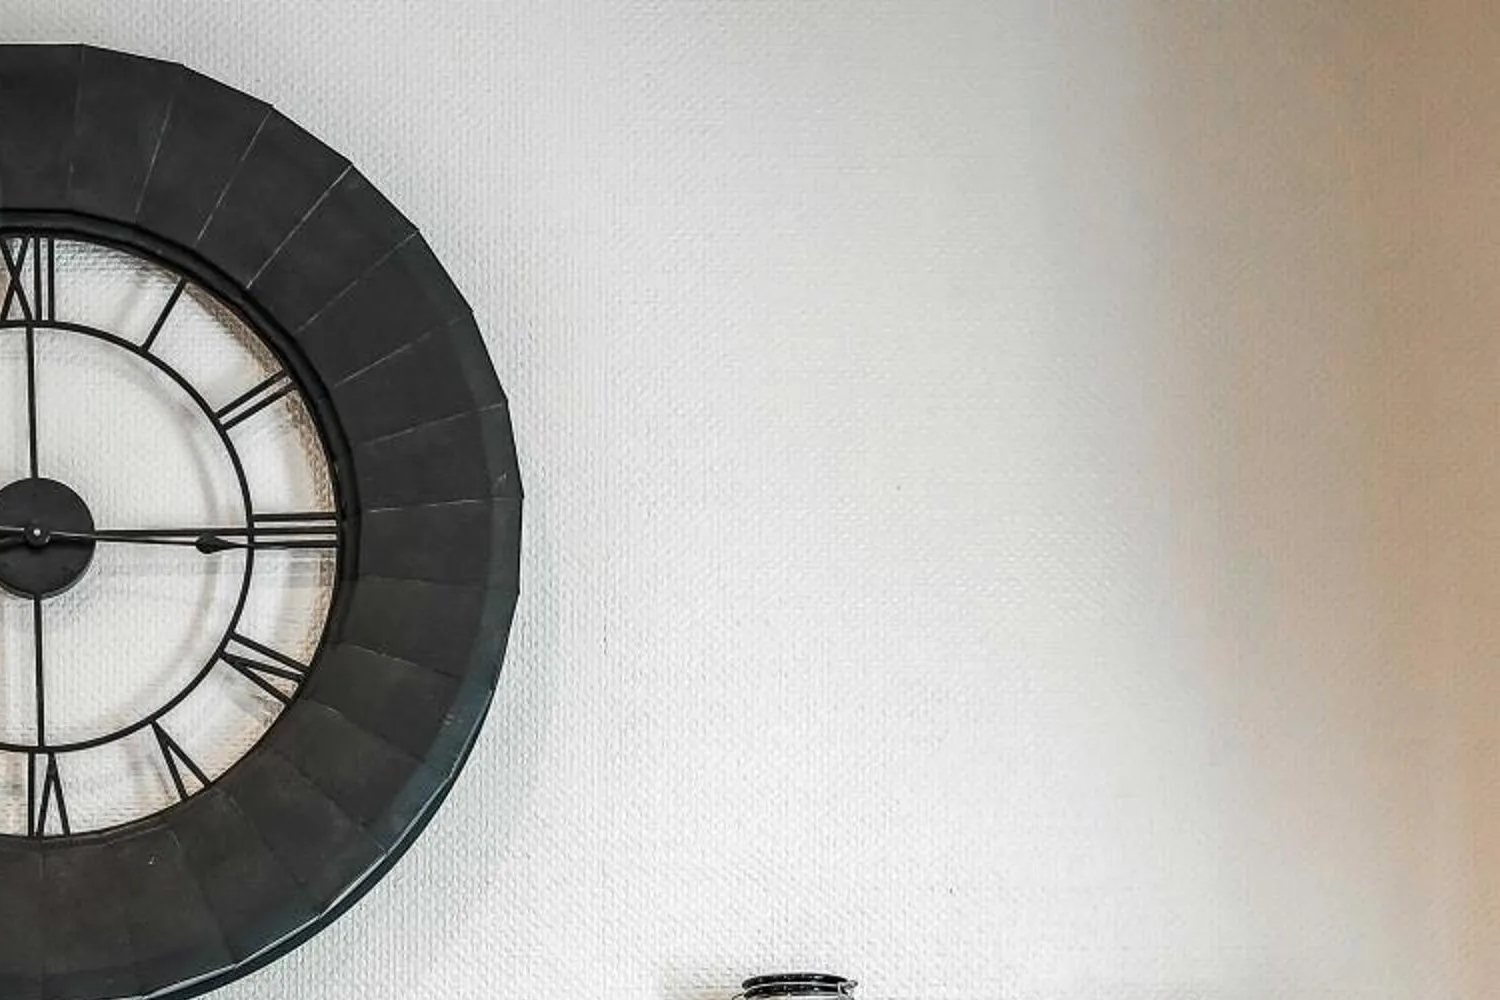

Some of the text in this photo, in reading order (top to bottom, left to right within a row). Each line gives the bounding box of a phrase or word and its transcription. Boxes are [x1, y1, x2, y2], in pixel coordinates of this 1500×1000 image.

[212, 369, 299, 431] II
[249, 510, 340, 549] III
[219, 632, 311, 706] IV
[27, 751, 71, 837] VI
[150, 720, 212, 800] V
